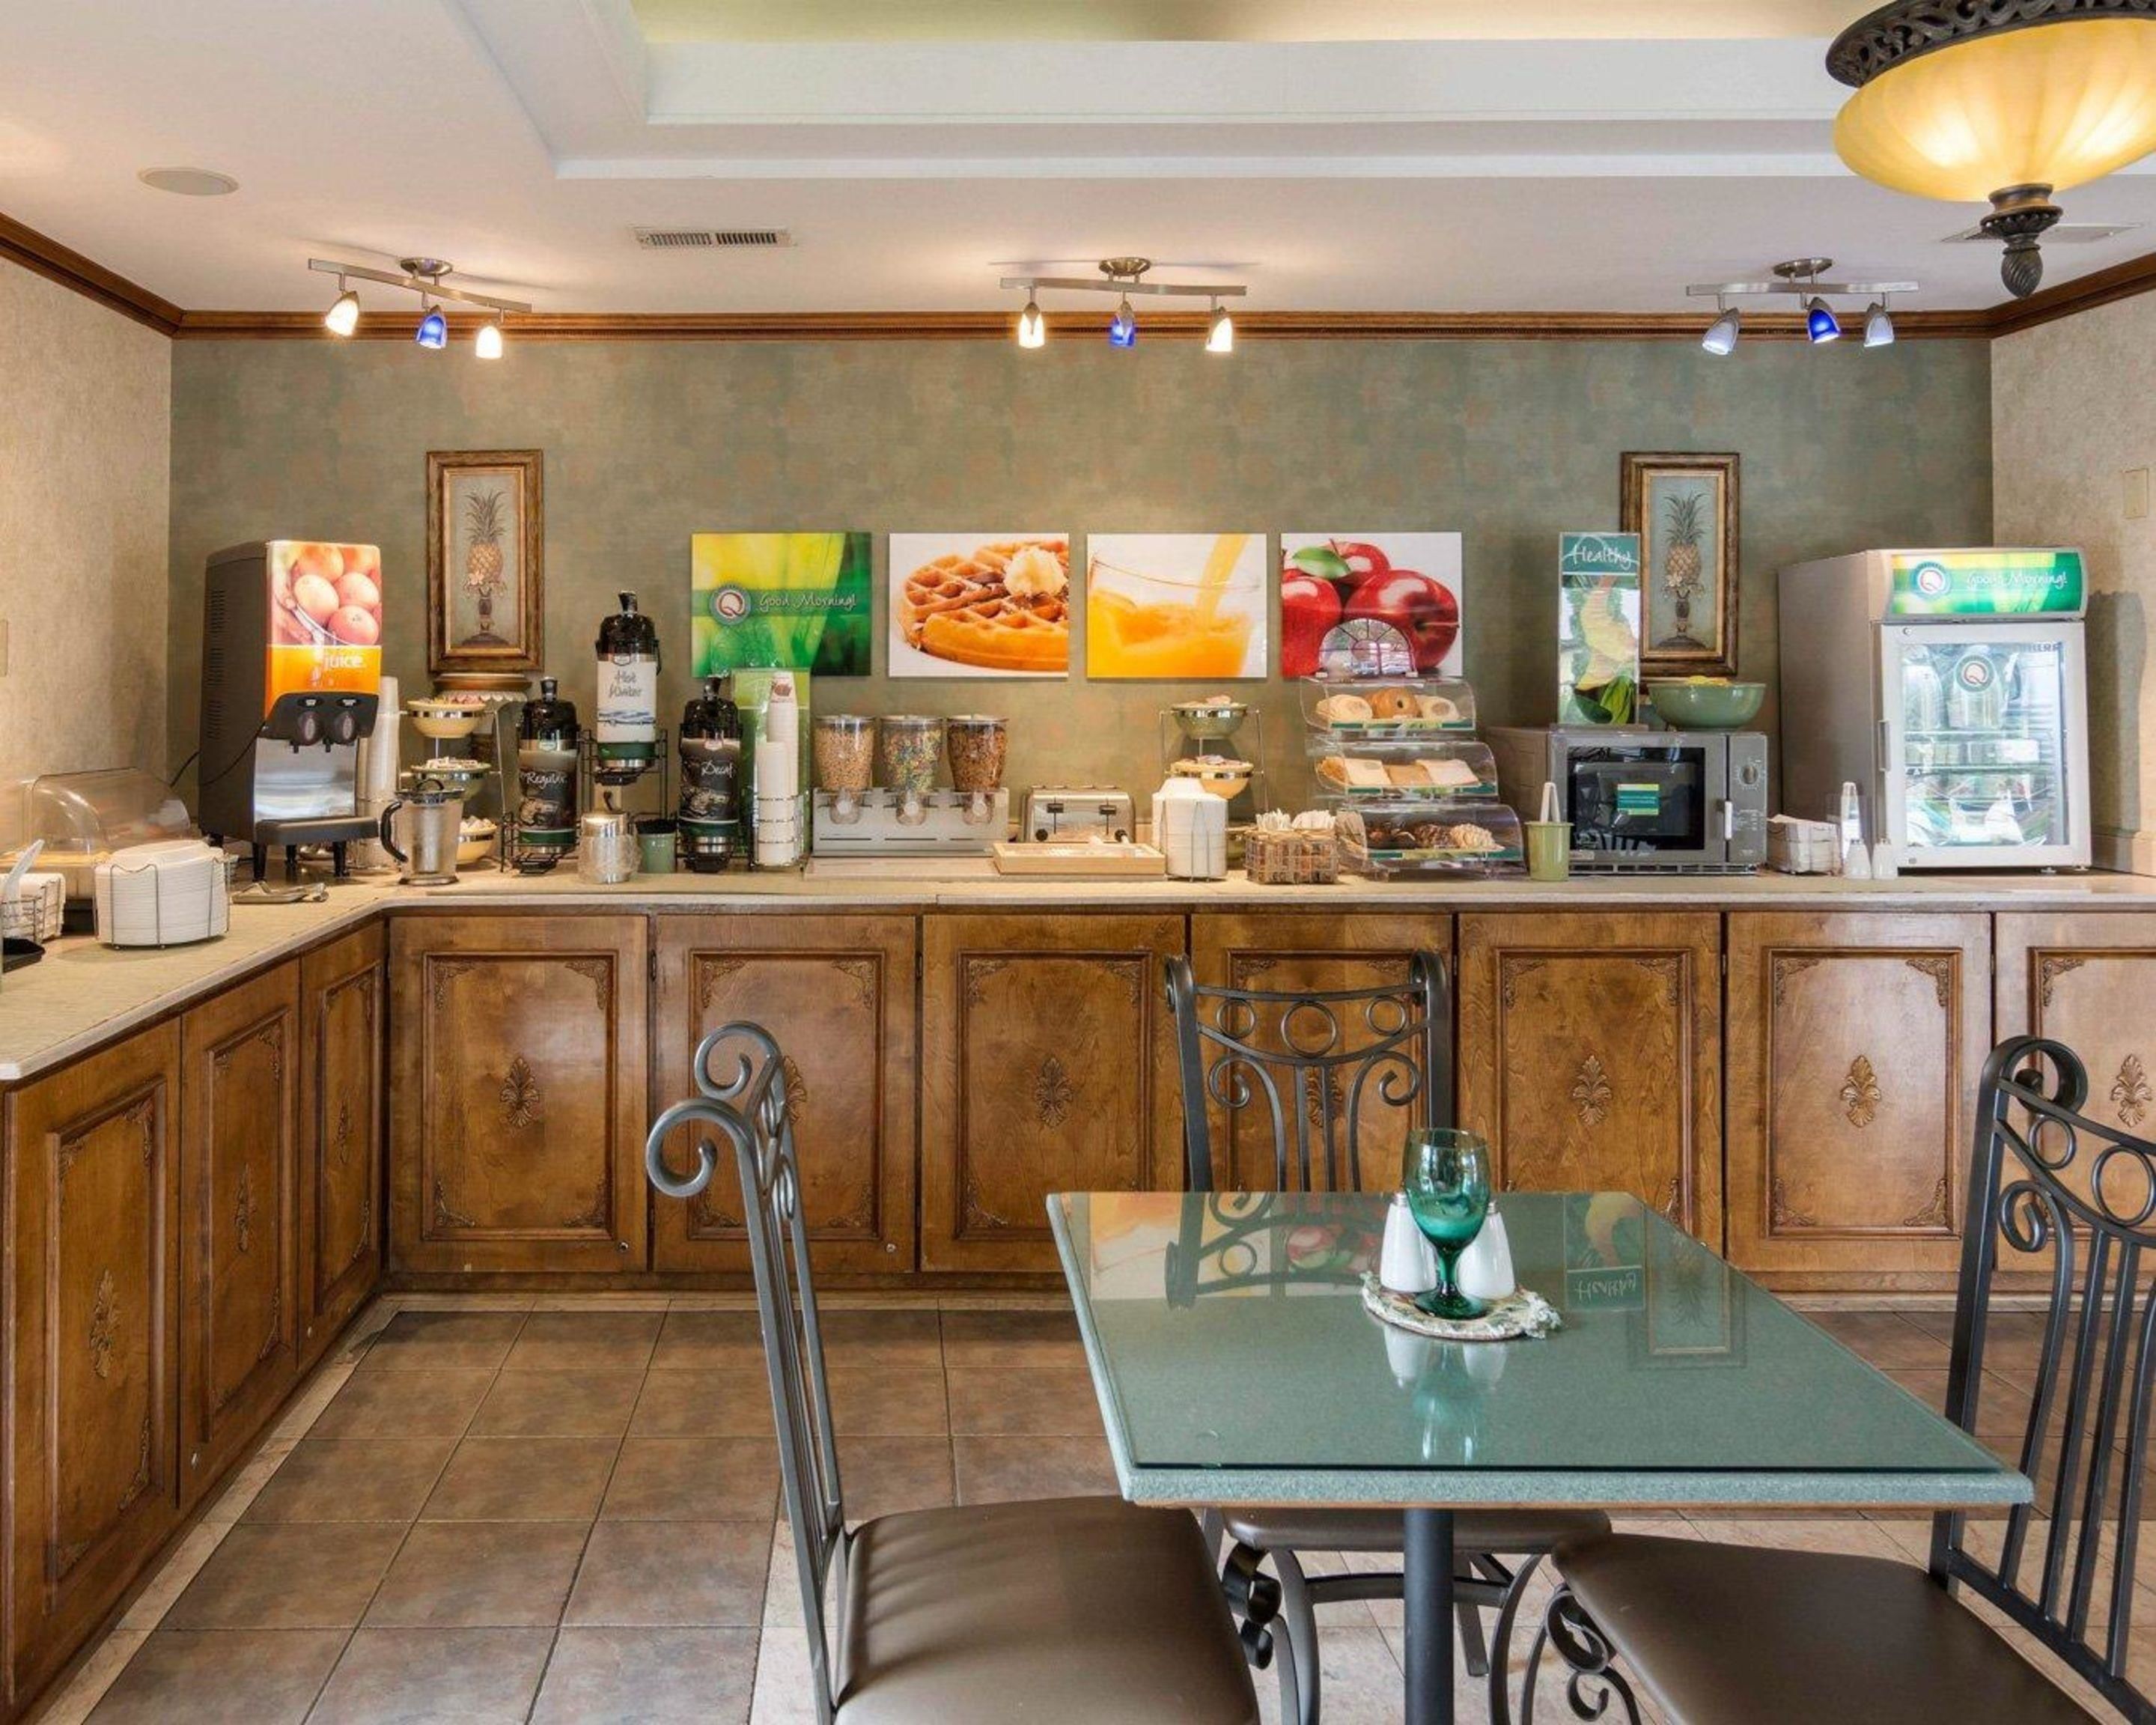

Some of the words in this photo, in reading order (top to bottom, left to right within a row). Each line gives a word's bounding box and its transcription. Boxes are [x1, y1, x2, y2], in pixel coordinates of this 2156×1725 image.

[1573, 544, 1632, 571] Healthy
[1999, 570, 2068, 590] Morning!
[759, 593, 790, 612] Good
[791, 592, 857, 612] Morning!
[701, 759, 734, 779] Decaf
[523, 770, 567, 790] Regular
